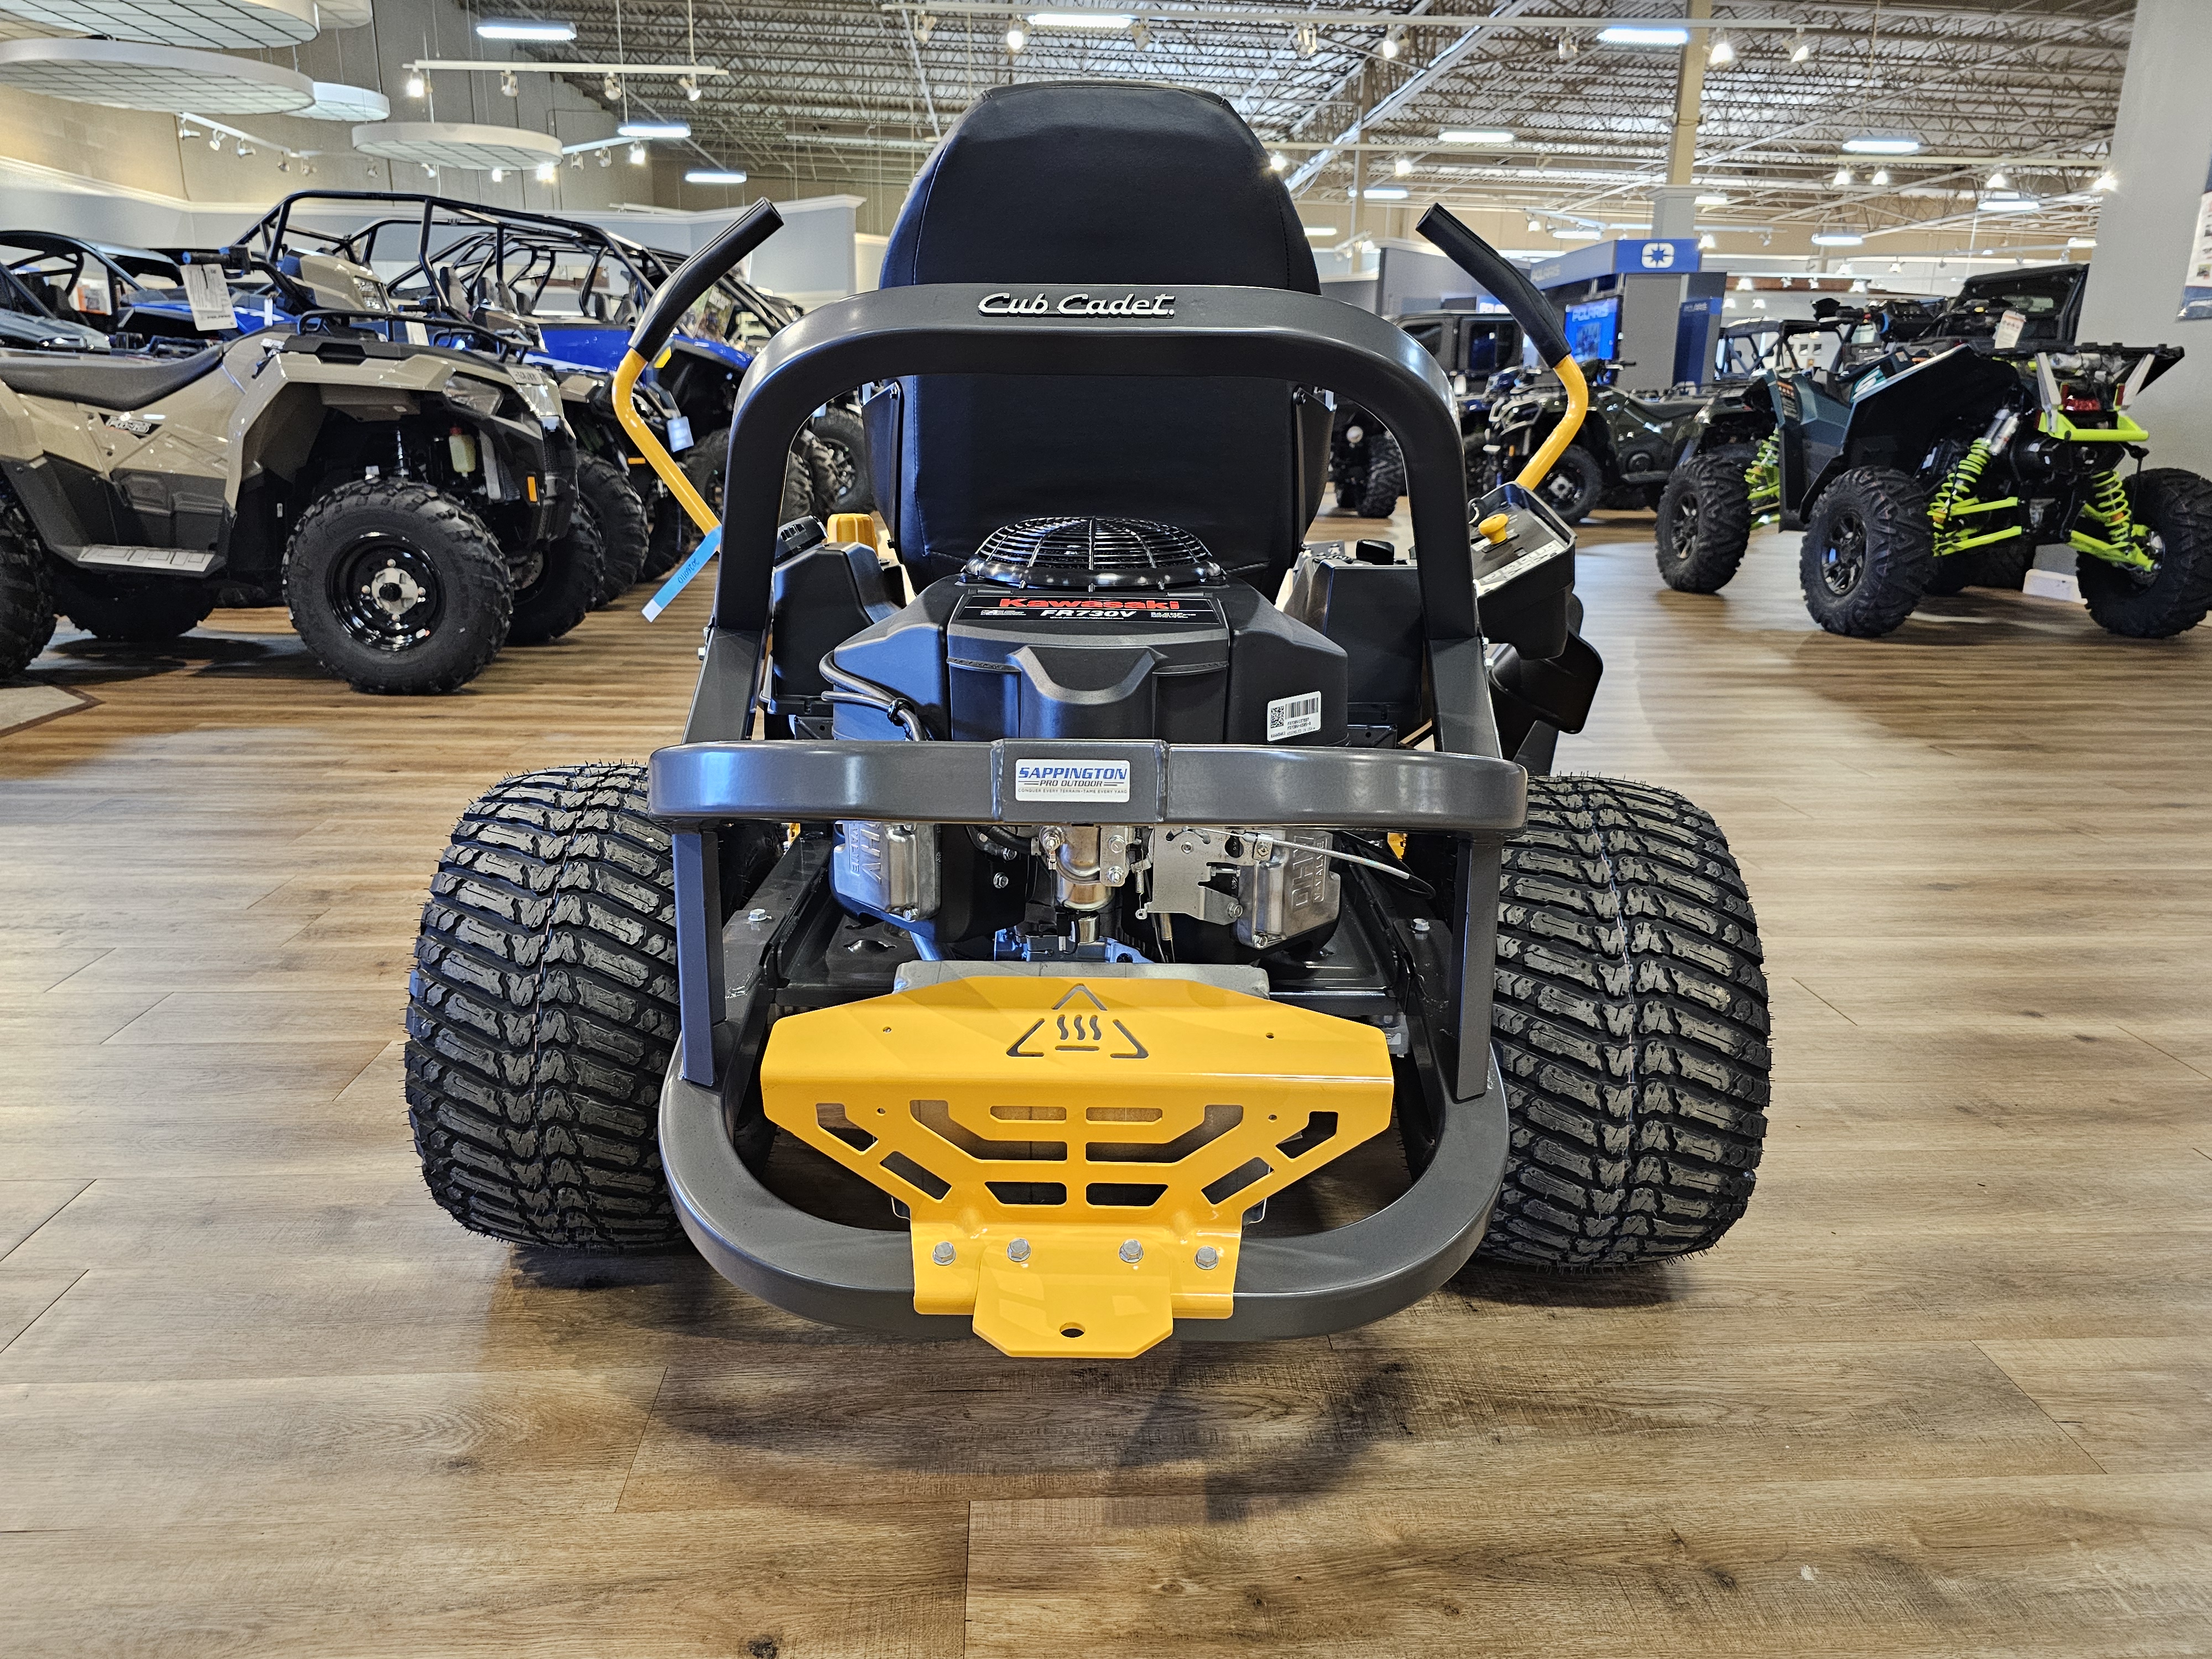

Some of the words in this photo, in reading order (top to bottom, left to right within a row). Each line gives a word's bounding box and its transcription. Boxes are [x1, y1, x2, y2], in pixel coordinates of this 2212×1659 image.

[978, 292, 1048, 315] Cub
[1572, 305, 1609, 322] POLARIS
[999, 598, 1180, 609] Kawasaki
[1040, 609, 1137, 618] FR730V
[1018, 767, 1128, 780] SAPPINGTON
